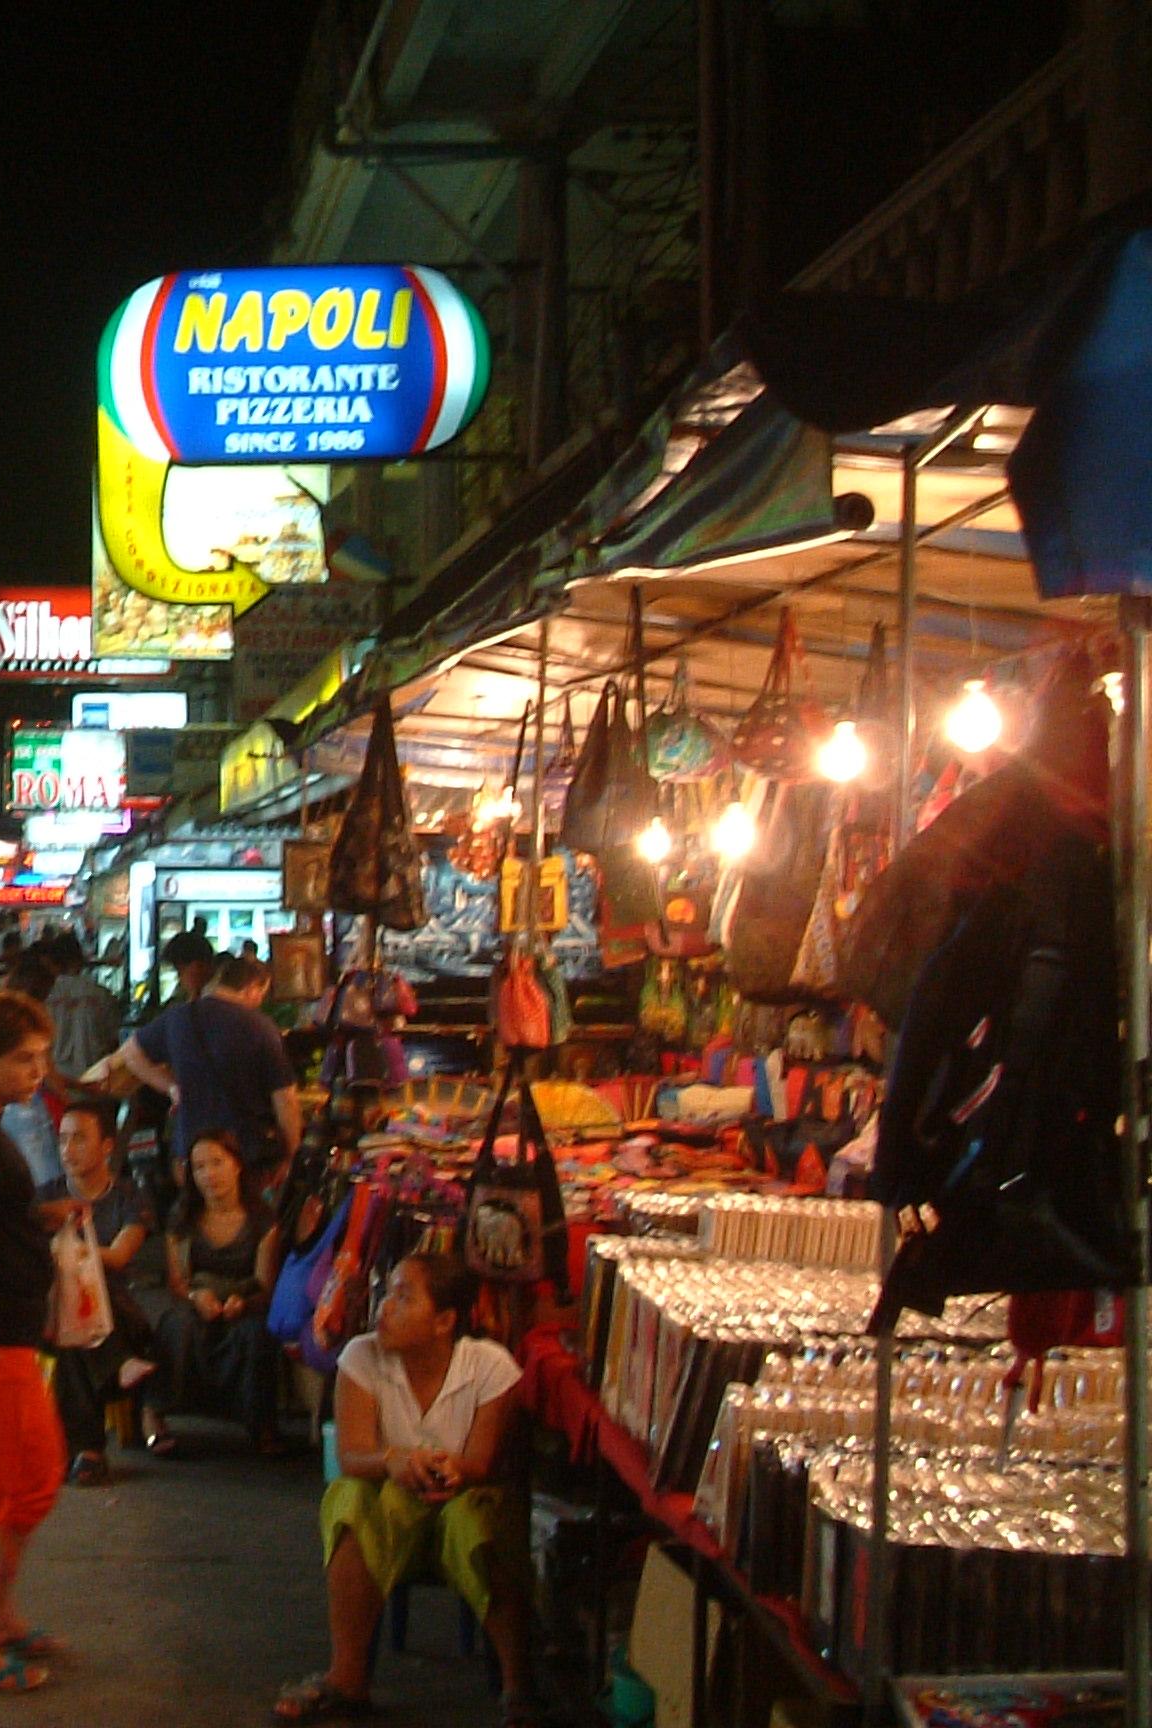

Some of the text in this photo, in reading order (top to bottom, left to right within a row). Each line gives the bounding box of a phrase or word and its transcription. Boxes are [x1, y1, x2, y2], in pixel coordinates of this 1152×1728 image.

[174, 287, 414, 353] NAPOLI
[188, 364, 400, 394] RISTORANTE
[215, 396, 374, 425] PIZZERIA
[224, 431, 297, 453] SINCE
[12, 770, 111, 808] ROMA
